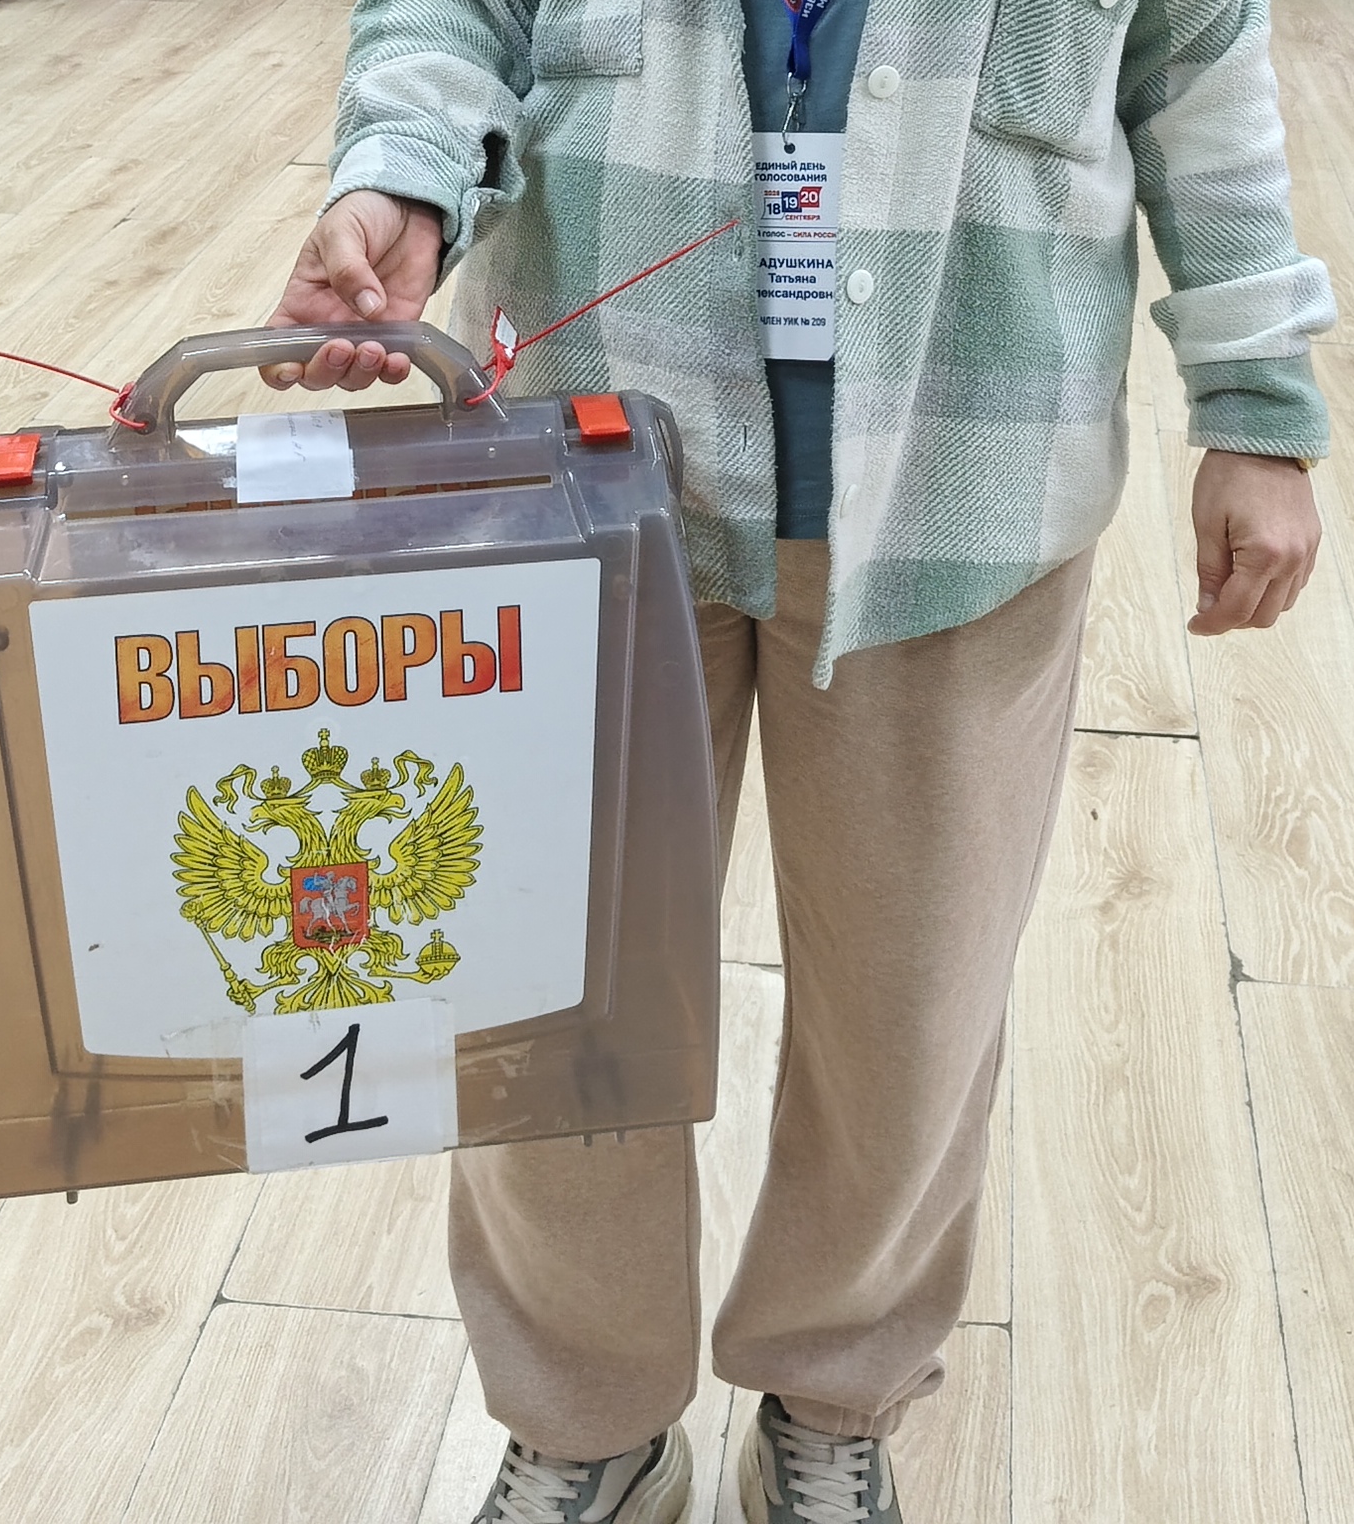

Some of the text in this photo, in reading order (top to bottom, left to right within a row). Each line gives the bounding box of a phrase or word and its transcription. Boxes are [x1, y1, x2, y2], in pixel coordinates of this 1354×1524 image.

[755, 160, 826, 172] ЕДИНЫЙ ДЕНЬ
[754, 173, 827, 182] ГОЛОСОВАНИЯ
[767, 191, 819, 215] 18 19 20
[758, 258, 834, 269] АДУШКИНА
[768, 273, 817, 284] Татьяна
[760, 316, 782, 326] ЧЛЕН
[783, 317, 800, 327] УИК
[114, 604, 523, 725] ВЫБОРЫ
[300, 1022, 389, 1144] 1
